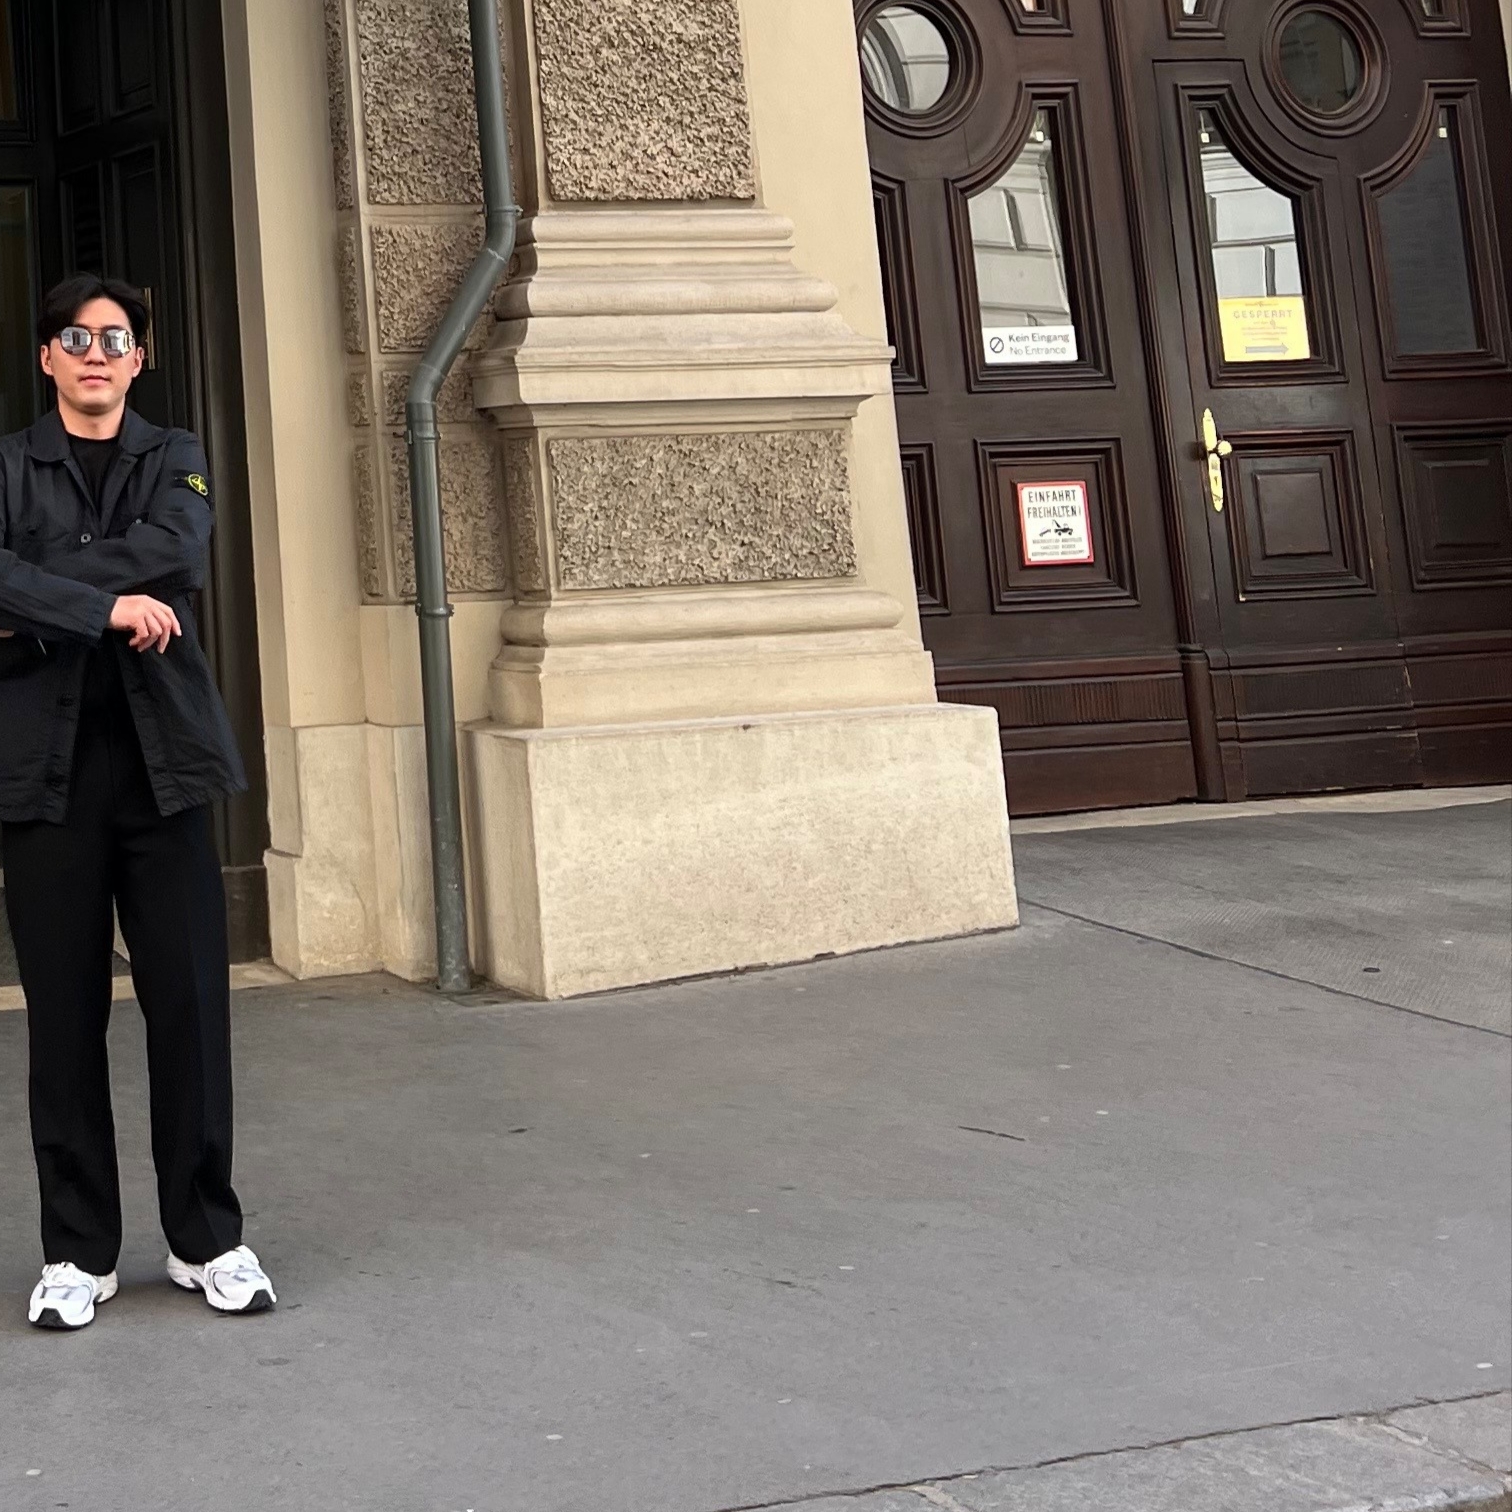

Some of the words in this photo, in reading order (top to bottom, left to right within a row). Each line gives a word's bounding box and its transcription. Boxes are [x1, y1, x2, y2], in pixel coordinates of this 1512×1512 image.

[1008, 333, 1030, 343] Kein
[1031, 332, 1070, 344] Eingang
[1009, 346, 1023, 356] No
[1025, 345, 1067, 355] Entrance
[1028, 490, 1076, 503] EINFAHRT
